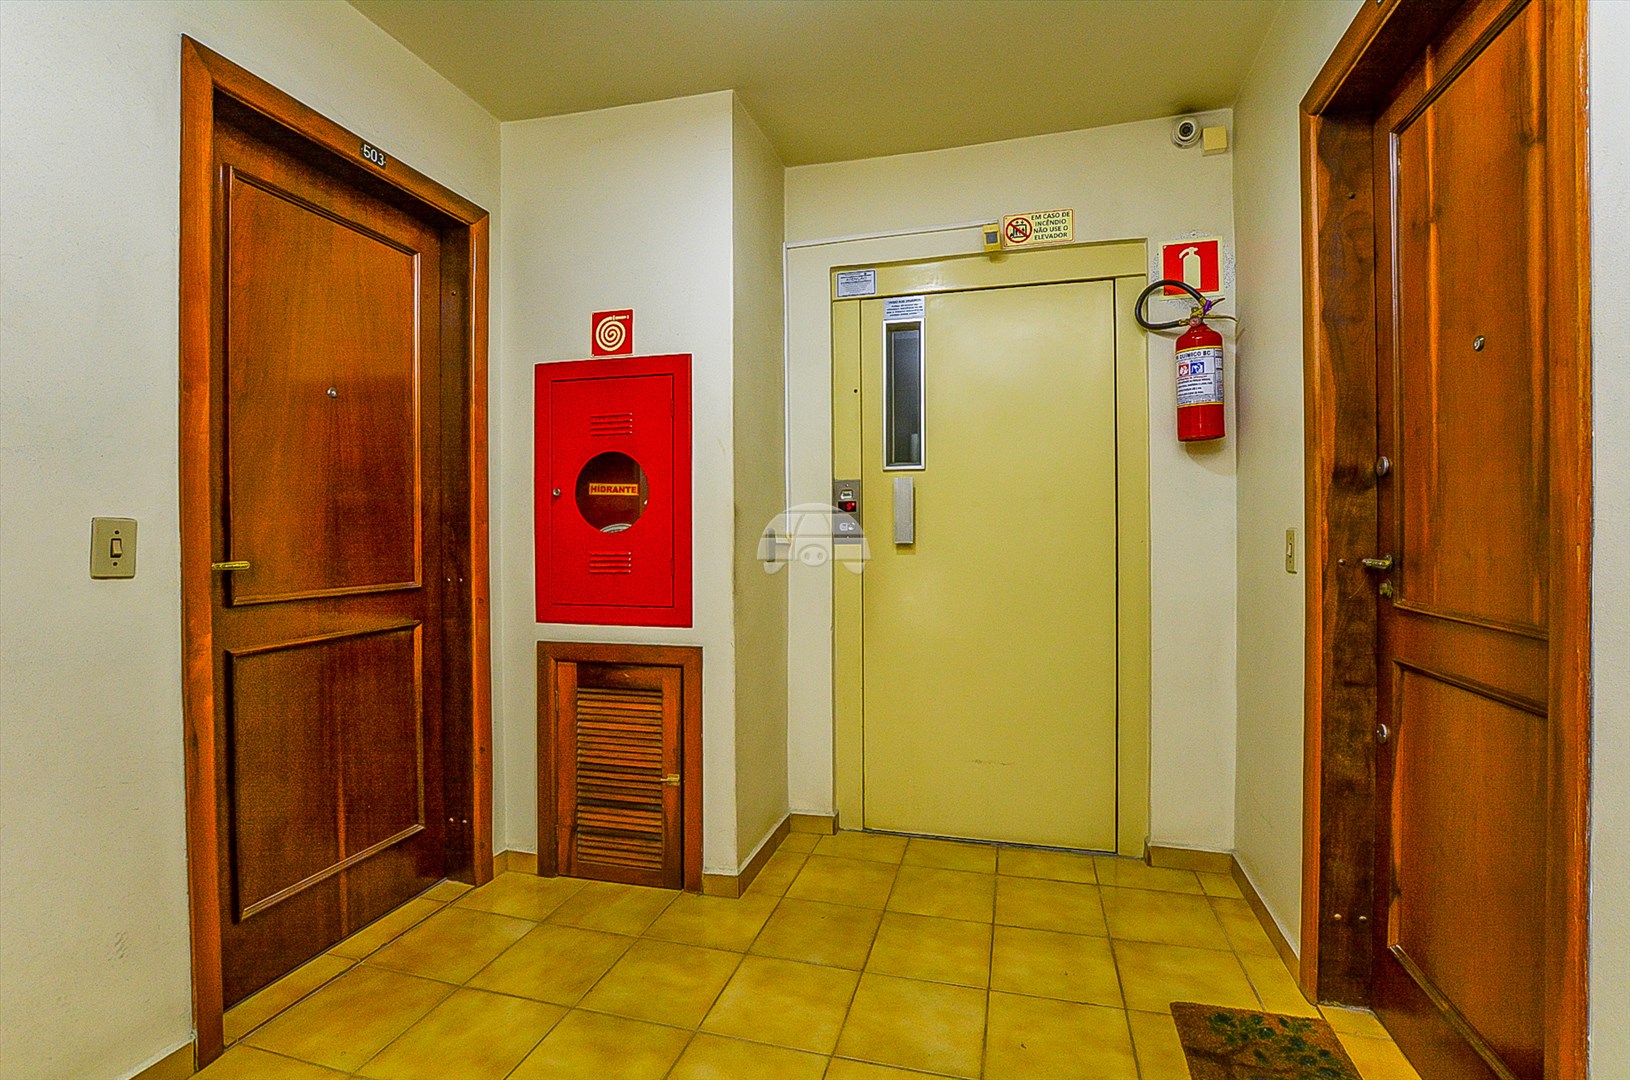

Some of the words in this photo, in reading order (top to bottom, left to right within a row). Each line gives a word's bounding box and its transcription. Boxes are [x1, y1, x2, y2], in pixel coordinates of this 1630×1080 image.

[363, 144, 385, 166] 503
[1043, 212, 1060, 220] CASO
[1035, 218, 1067, 227] INCÊNDIO
[1033, 225, 1048, 234] NÃO
[1034, 232, 1068, 240] ELEVADOR
[591, 485, 637, 494] HIDRANTE
